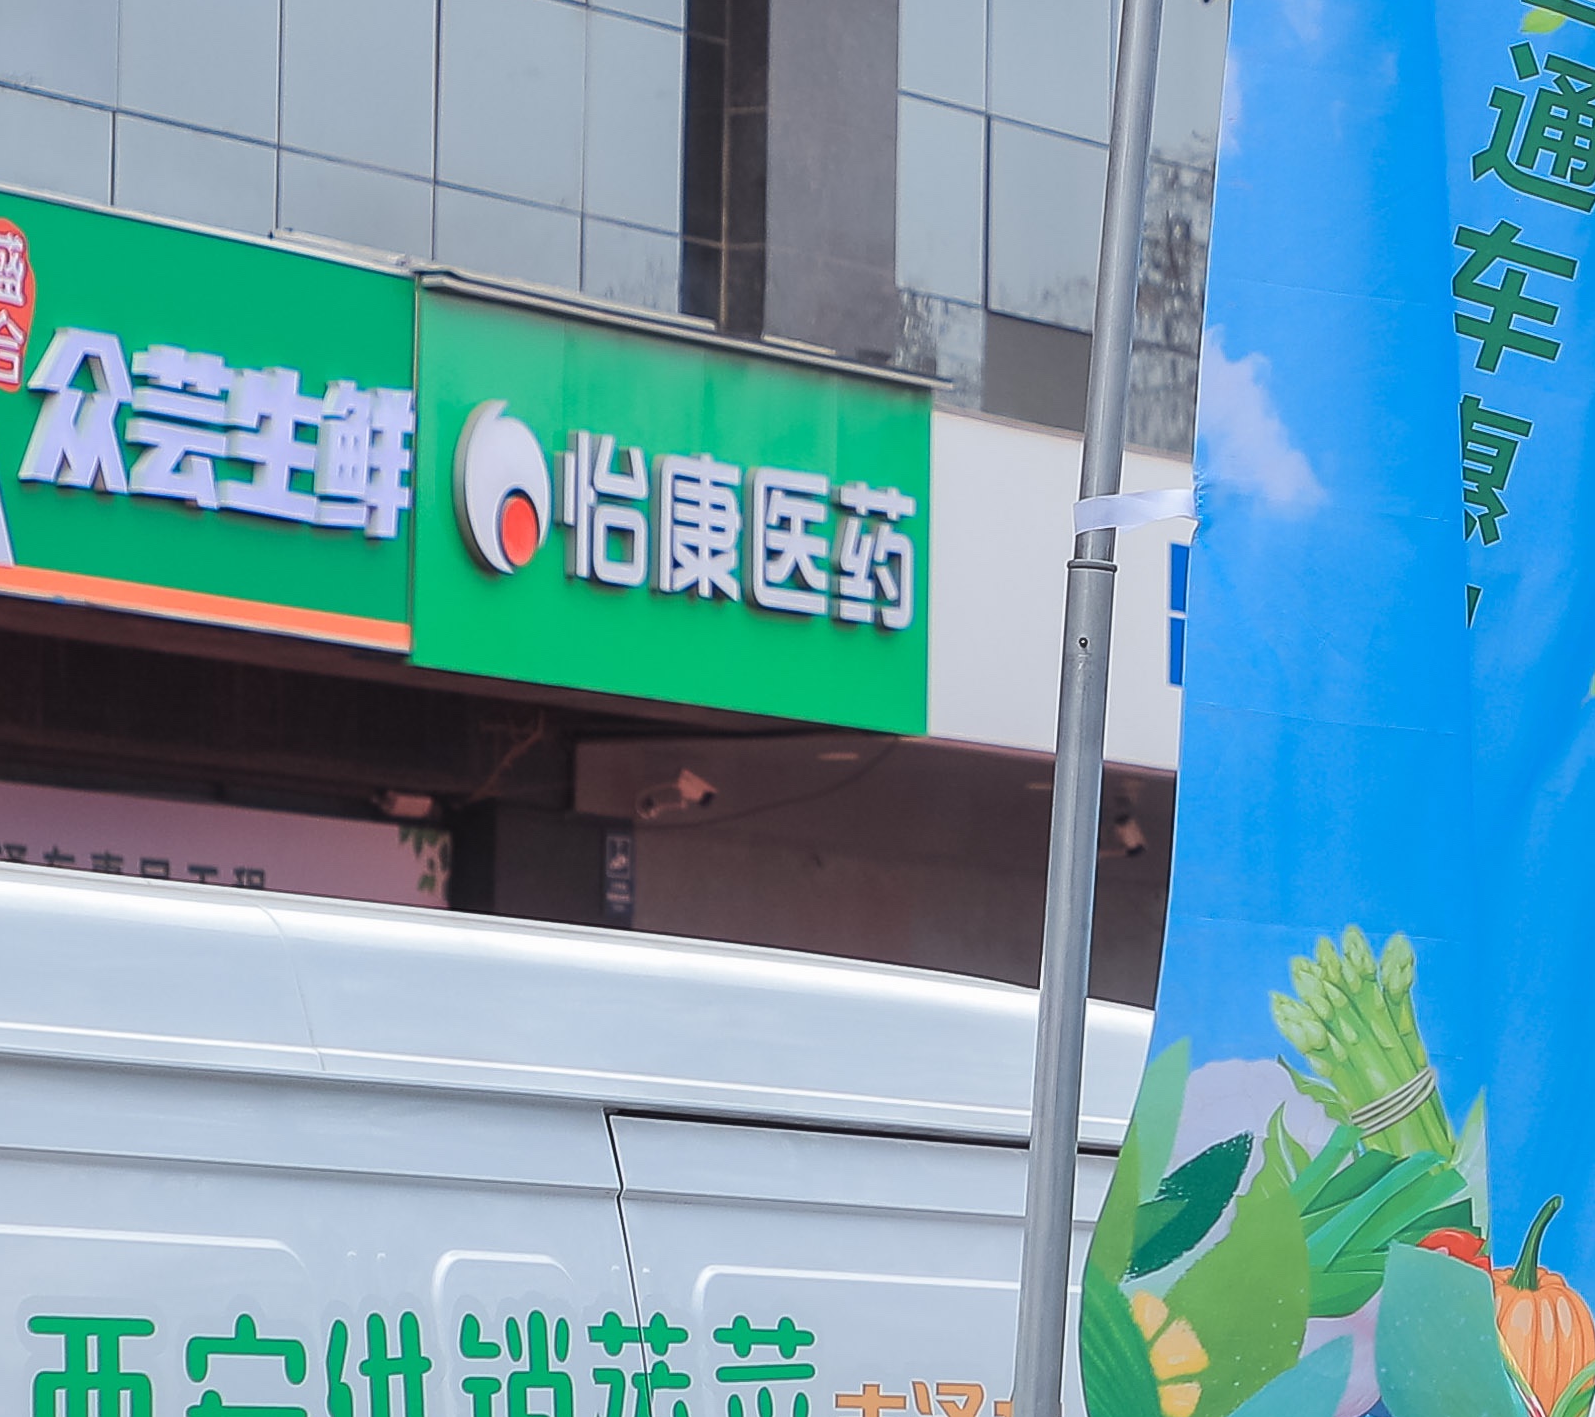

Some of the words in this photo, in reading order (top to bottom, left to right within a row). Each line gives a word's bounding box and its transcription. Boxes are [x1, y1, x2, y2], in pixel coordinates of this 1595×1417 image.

[17, 327, 415, 539] 众芸生鲜
[557, 431, 916, 630] 怡康医药
